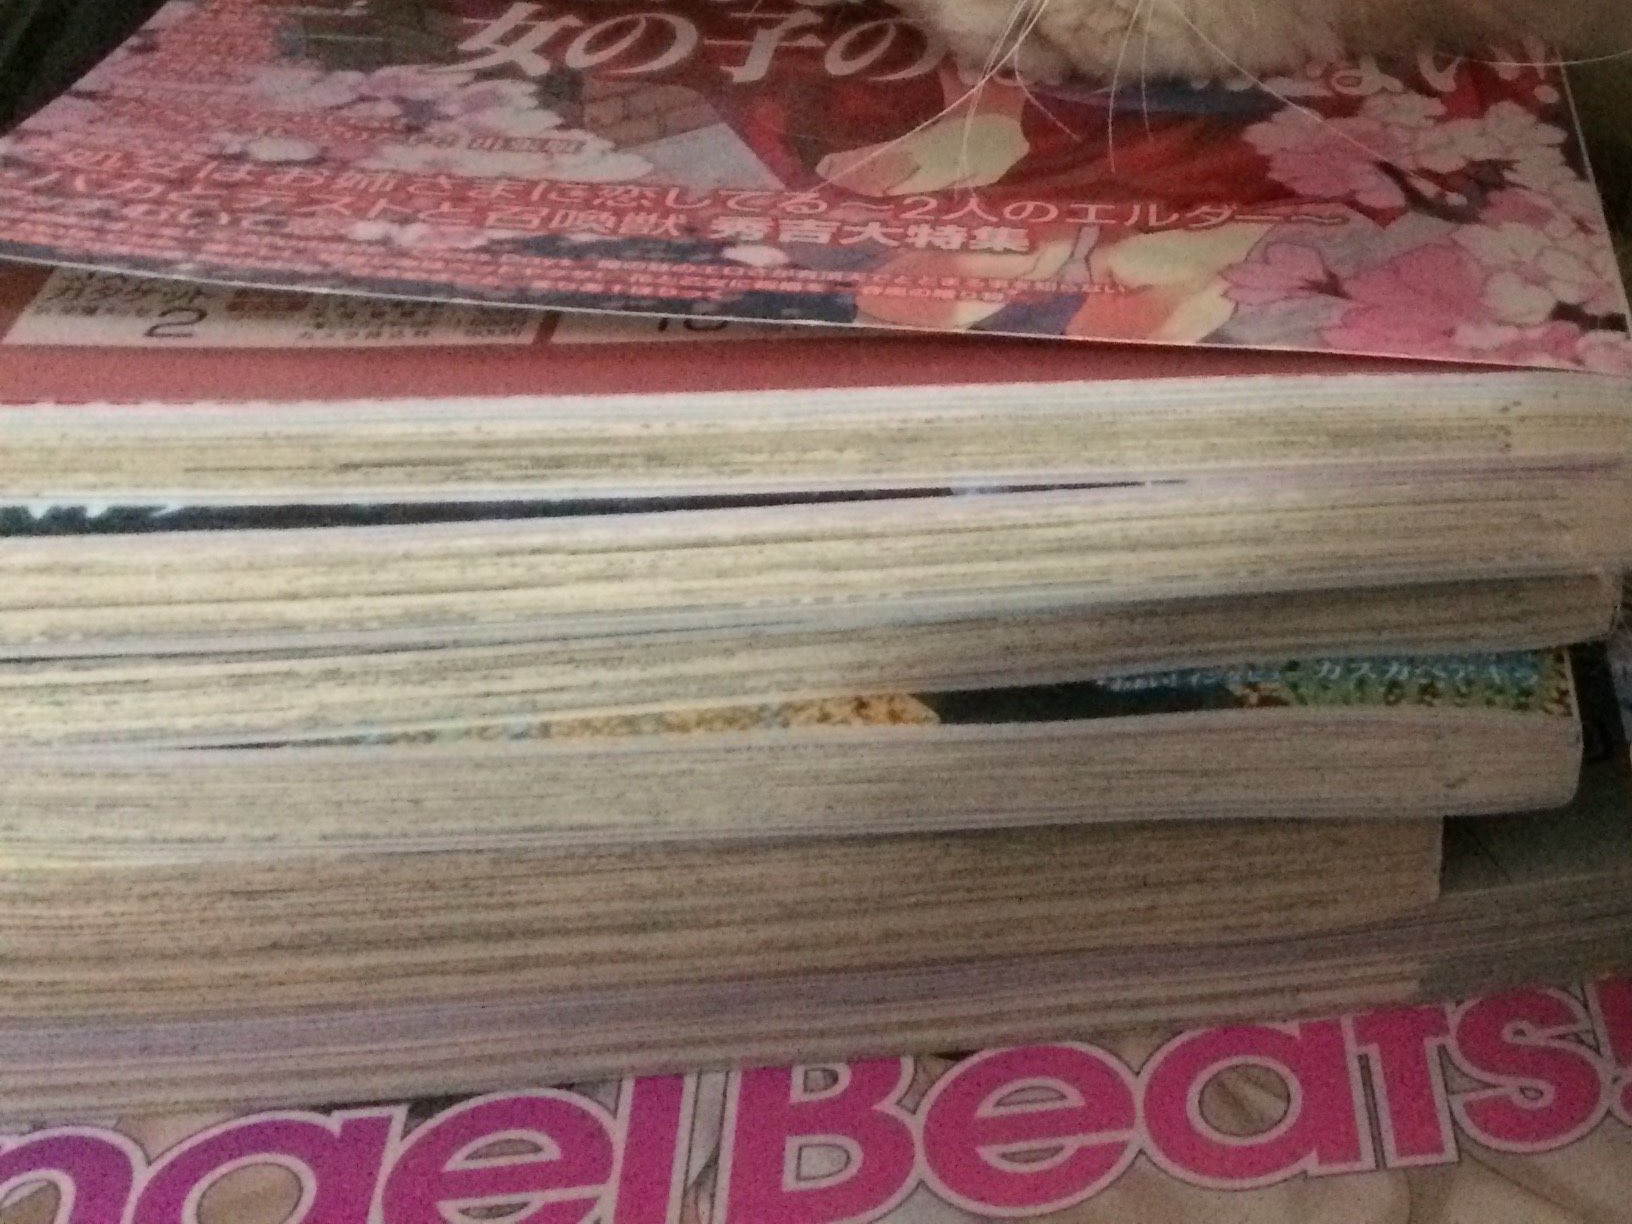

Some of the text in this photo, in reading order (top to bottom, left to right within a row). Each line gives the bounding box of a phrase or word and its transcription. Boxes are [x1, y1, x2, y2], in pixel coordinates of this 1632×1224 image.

[709, 215, 1031, 254] 秀吉大特集
